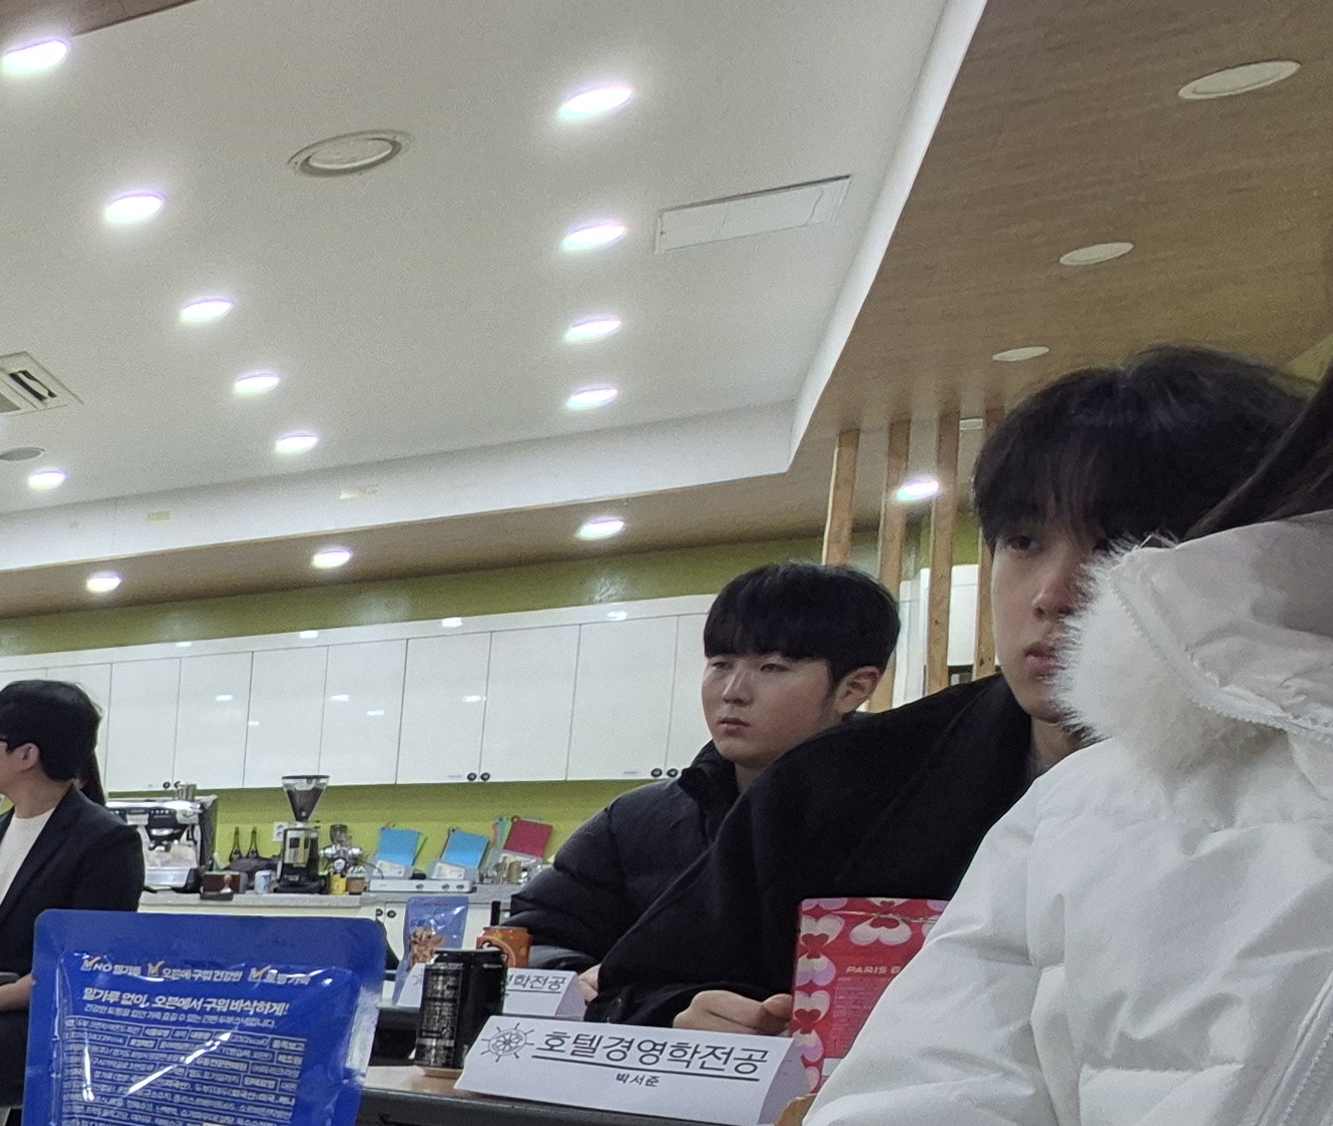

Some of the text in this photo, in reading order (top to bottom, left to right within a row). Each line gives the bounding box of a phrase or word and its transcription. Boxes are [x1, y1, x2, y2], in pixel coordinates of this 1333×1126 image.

[846, 966, 887, 974] PARIS
[82, 987, 121, 1003] 밀가루
[203, 998, 230, 1012] 구워
[229, 999, 290, 1015] 바삭하게!
[536, 1031, 769, 1075] 호텔경영학전공
